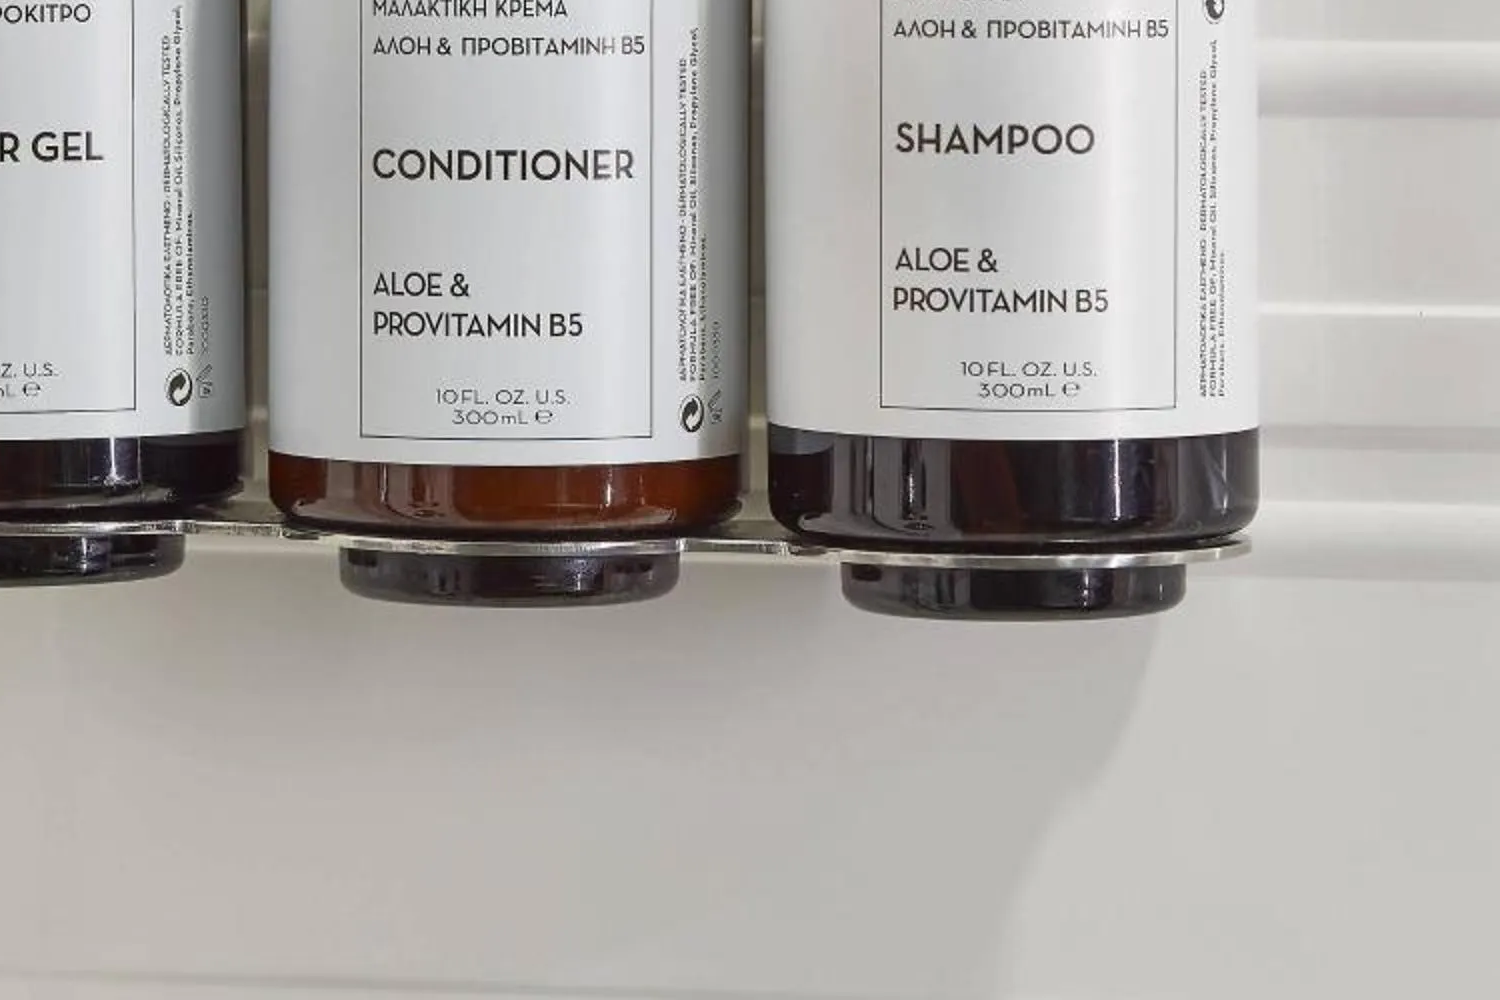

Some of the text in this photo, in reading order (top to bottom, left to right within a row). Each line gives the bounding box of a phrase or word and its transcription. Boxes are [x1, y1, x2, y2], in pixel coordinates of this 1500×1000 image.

[893, 19, 1169, 39] ΑΛΟΗ & ΠΡΟΒΙΤΑΜΙΝΗ B5
[373, 36, 645, 56] ΑΛΟΗ & ΠΡΟΒΙΤΑΜΙΝΗ B5
[31, 131, 104, 163] GEL
[896, 123, 1095, 156] SHAMPOO
[373, 148, 635, 182] CONDITIONER
[895, 248, 998, 274] ALOE &
[372, 272, 470, 297] ALOE &
[894, 287, 1109, 314] PROVITAMIN B5
[373, 311, 583, 338] PROVITAMIN B5
[1021, 361, 1057, 377] OZ.
[1062, 361, 1098, 377] U.S.
[495, 388, 529, 405] OZ.
[535, 388, 571, 405] U.S.
[978, 383, 1057, 399] 300mL
[452, 410, 529, 425] 300mL
